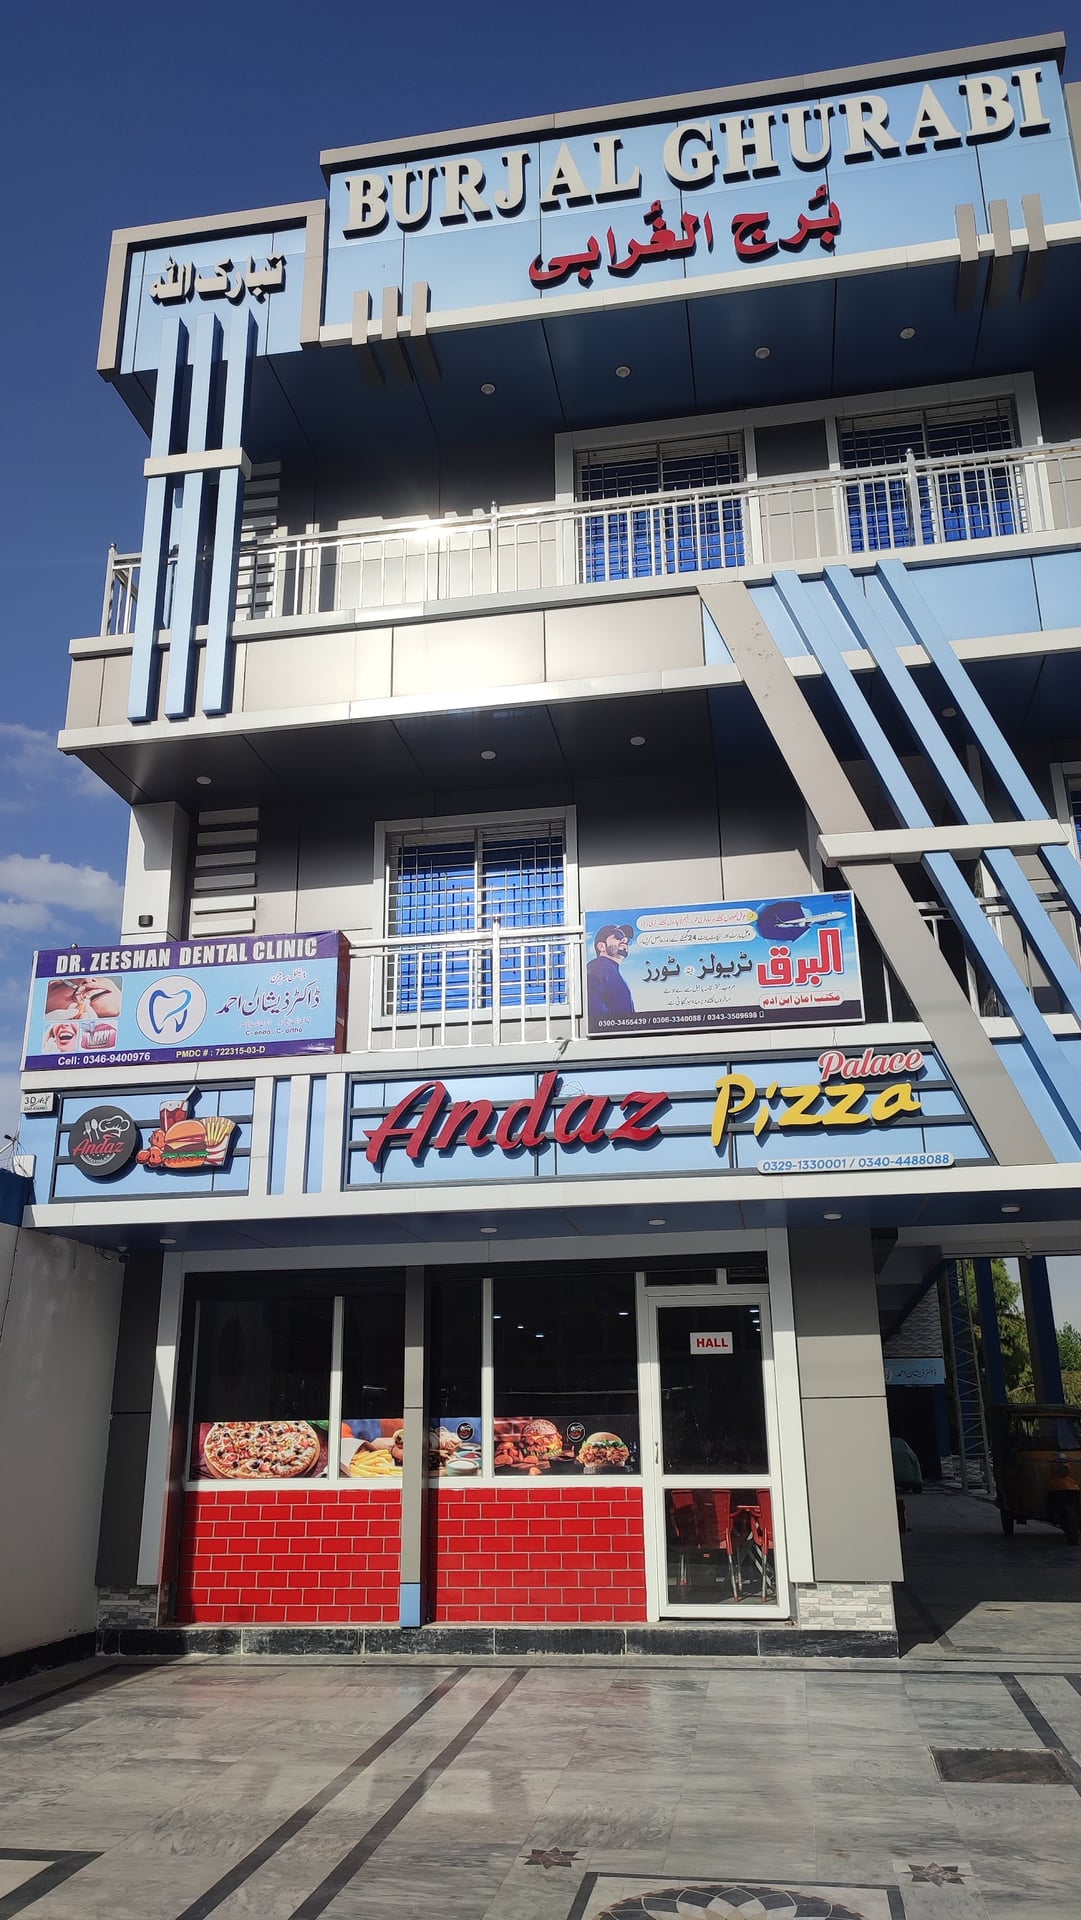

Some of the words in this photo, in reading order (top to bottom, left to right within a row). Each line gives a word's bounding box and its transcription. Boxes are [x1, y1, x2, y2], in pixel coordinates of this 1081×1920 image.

[342, 137, 641, 236] BURJAL
[663, 67, 1051, 185] GHURABI
[688, 933, 697, 941] 24
[56, 954, 86, 974] DR.
[90, 948, 171, 972] ZEESHAN
[178, 942, 248, 966] DENTAL
[252, 937, 318, 961] CLINIC
[643, 954, 681, 982] ٹورز
[697, 950, 753, 979] ٹریولز
[757, 927, 843, 987] البرق
[215, 995, 242, 1015] احمد
[242, 984, 289, 1016] ذیشان
[285, 979, 320, 1017] ڈاکٹر
[57, 1054, 81, 1066] Cell:
[82, 1051, 151, 1065] 0346-9400976
[175, 1049, 201, 1059] PMDC
[215, 1046, 266, 1056] 722315-03-D
[818, 1048, 924, 1083] Palace
[24, 1096, 37, 1105] 3D
[362, 1070, 668, 1164] Andaz
[711, 1073, 922, 1147] Pizza
[72, 1135, 126, 1157] Andaz
[763, 1158, 847, 1172] 0329-1330001
[858, 1154, 950, 1168] 0340-4488088
[696, 1337, 729, 1348] HALL
